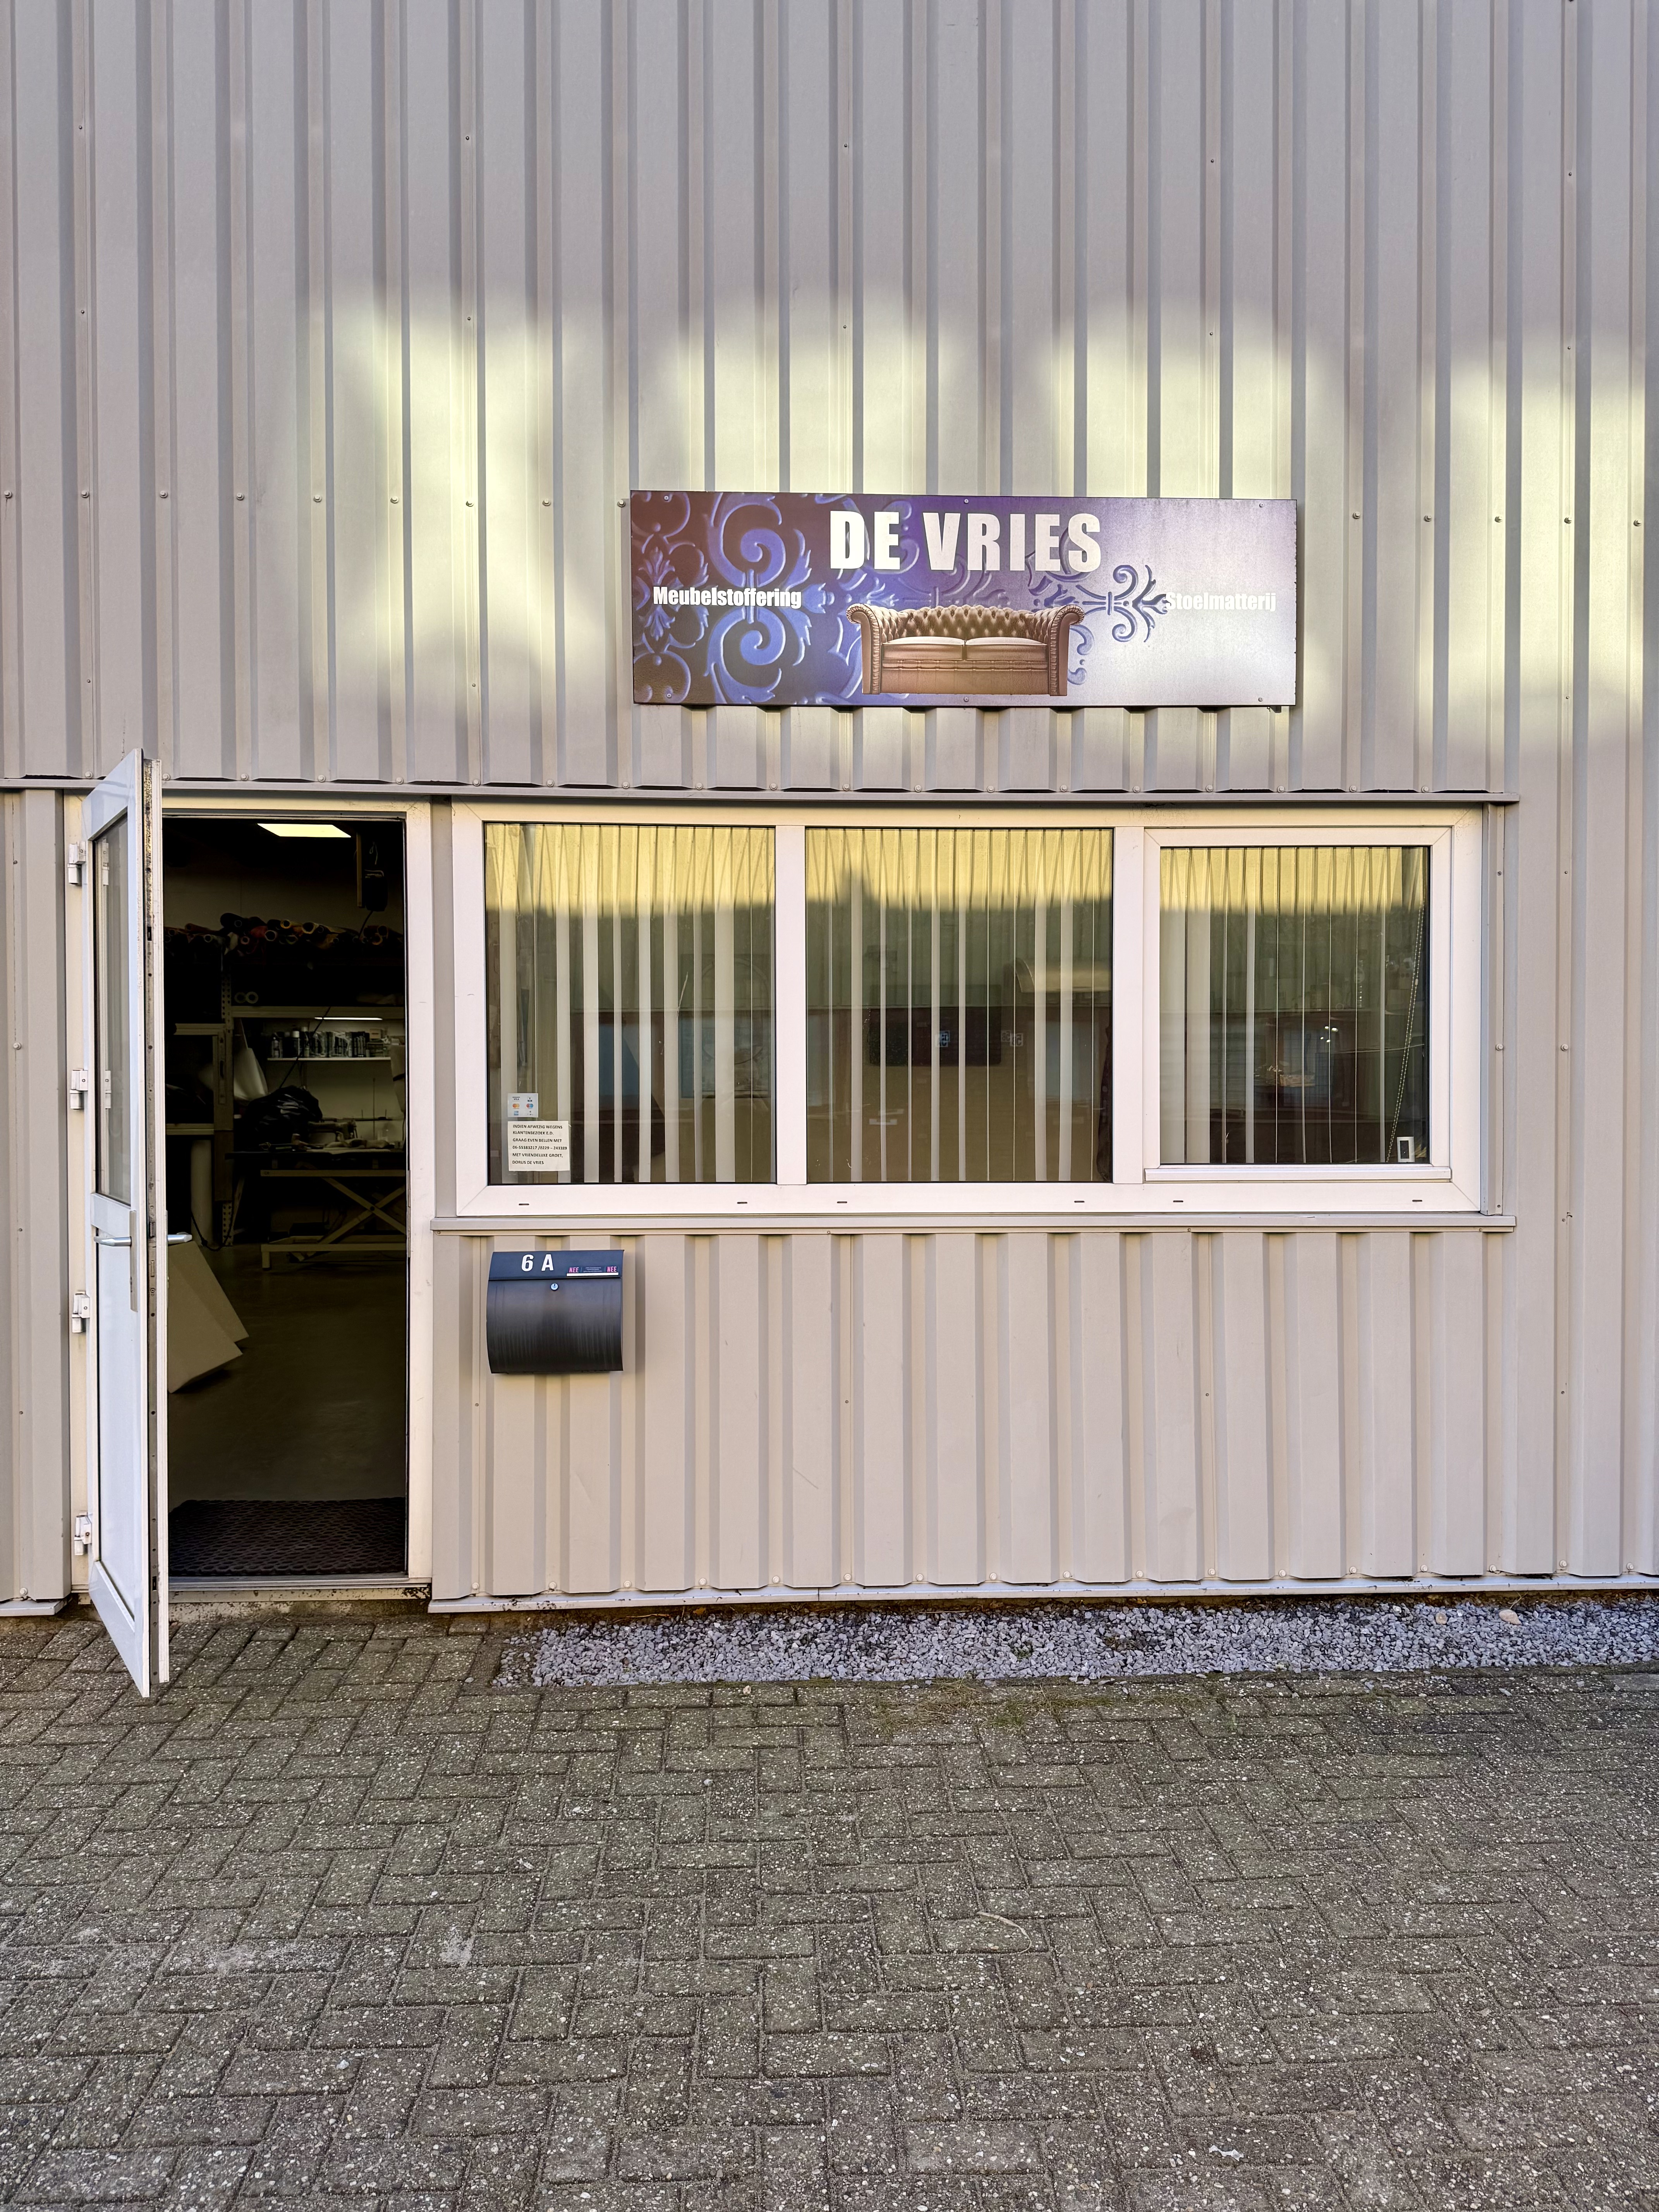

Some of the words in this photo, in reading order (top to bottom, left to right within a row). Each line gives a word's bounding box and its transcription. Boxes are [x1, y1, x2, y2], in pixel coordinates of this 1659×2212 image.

[830, 510, 900, 569] DE
[923, 513, 1101, 572] VRIES
[653, 586, 802, 609] Meubelstoffering
[1166, 592, 1276, 612] Stoelmatterij
[522, 1254, 534, 1272] 6
[541, 1254, 554, 1271] A
